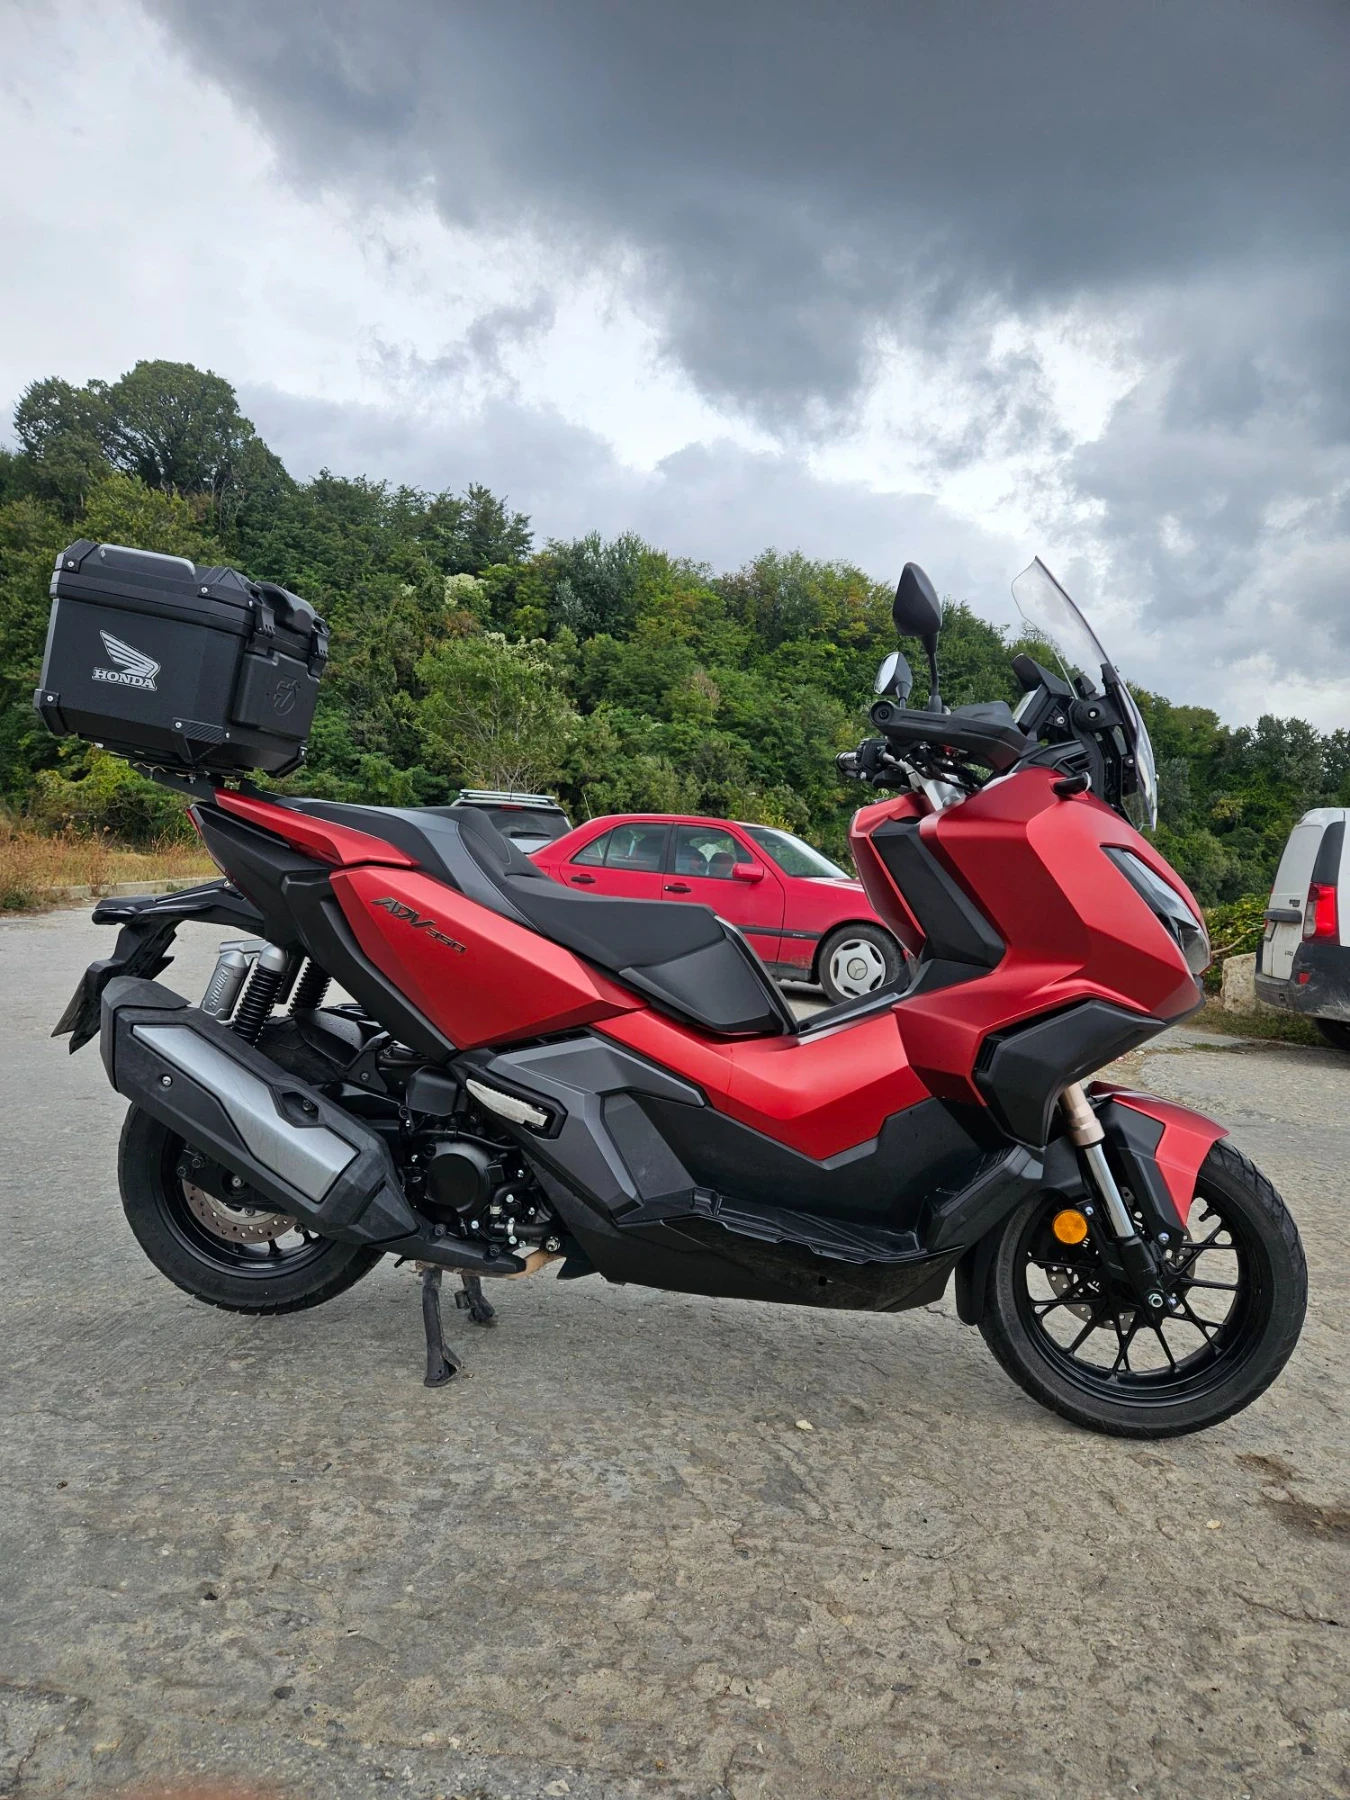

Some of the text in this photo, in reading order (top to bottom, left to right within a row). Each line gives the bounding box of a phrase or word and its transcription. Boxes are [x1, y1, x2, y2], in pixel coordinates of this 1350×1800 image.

[94, 669, 155, 689] HONDA
[370, 897, 468, 954] ADV 350
